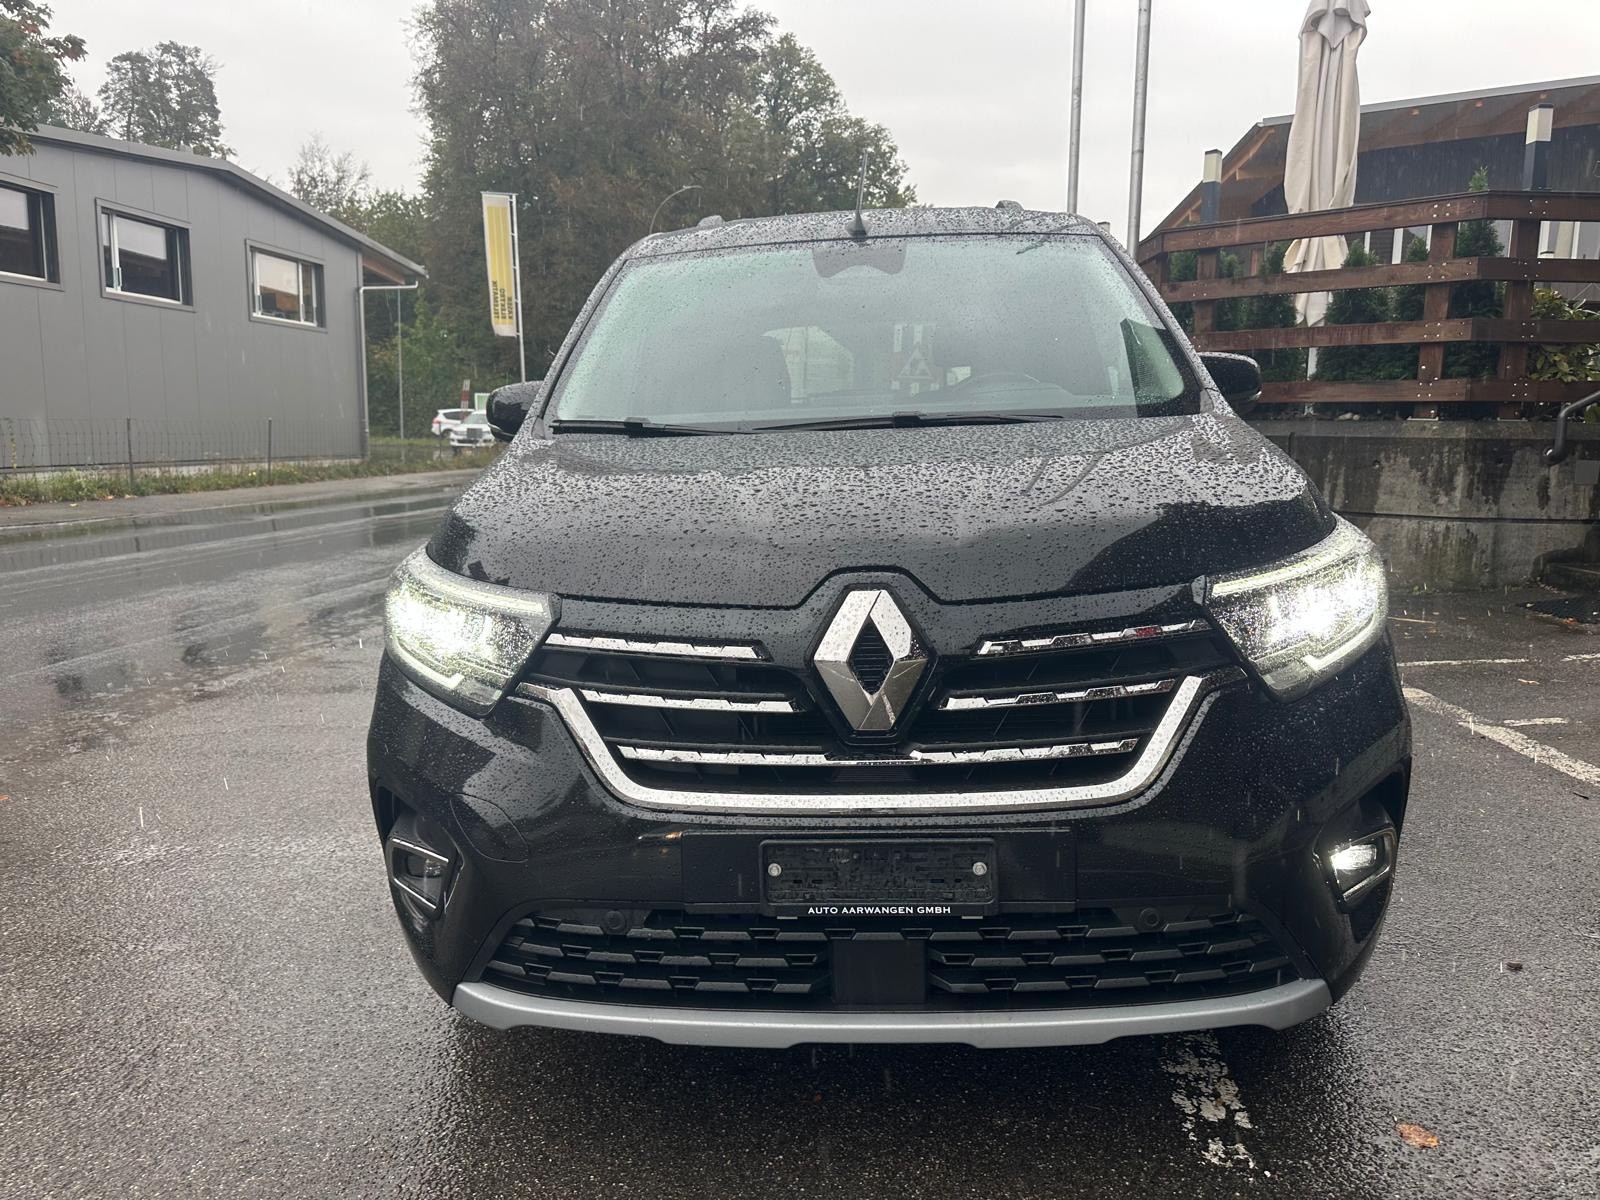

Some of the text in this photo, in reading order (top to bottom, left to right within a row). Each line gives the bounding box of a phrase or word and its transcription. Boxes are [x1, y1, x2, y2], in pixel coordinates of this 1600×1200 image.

[807, 906, 951, 915] AUTO AARWANGEN GMBH
